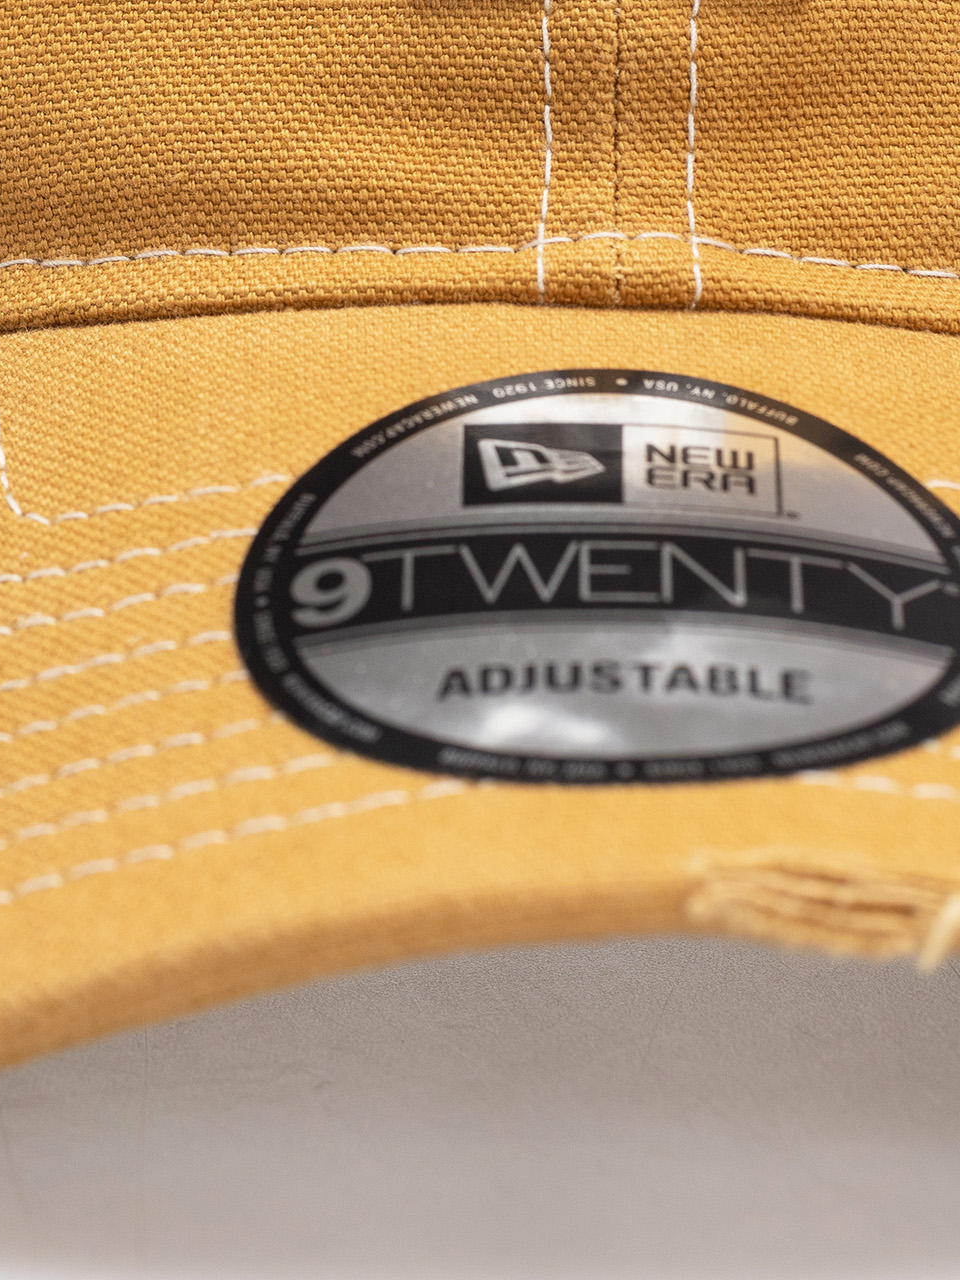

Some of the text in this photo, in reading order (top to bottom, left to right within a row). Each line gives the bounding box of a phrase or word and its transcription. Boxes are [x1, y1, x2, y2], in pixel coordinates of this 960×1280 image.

[492, 383, 538, 399] 1920
[544, 376, 597, 391] SINCE
[642, 377, 679, 392] USA
[645, 442, 756, 471] NEW
[645, 470, 756, 496] ERA
[290, 540, 943, 630] 9TWENTY
[436, 660, 814, 704] ADJUSTABLE
